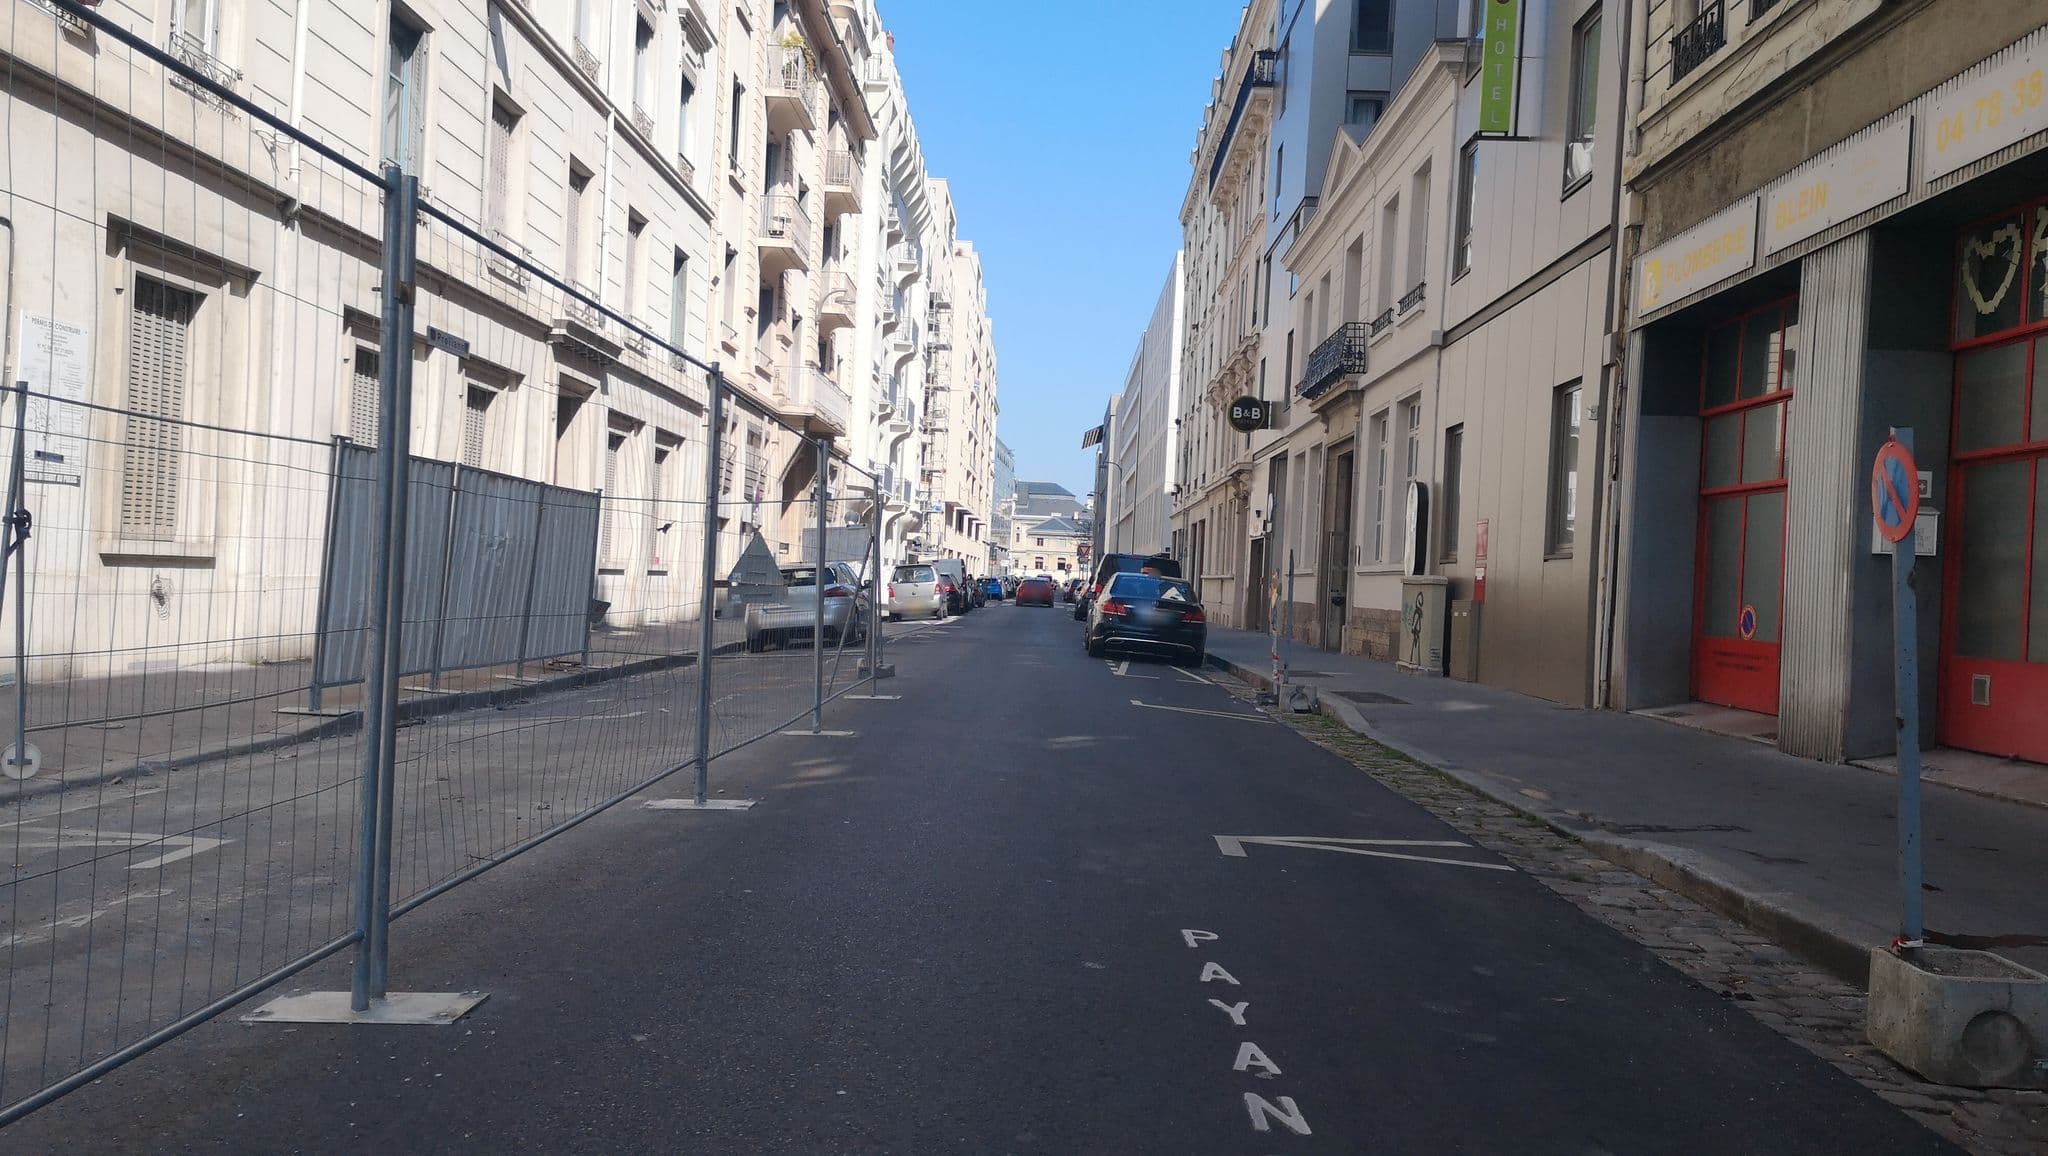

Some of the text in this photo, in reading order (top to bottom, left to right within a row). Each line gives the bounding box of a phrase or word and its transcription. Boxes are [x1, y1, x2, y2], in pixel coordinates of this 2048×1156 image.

[1489, 18, 1507, 124] HOTEL
[1936, 111, 1965, 154] 04
[1233, 406, 1261, 419] B&B
[1181, 928, 1312, 1135] PAYAN
